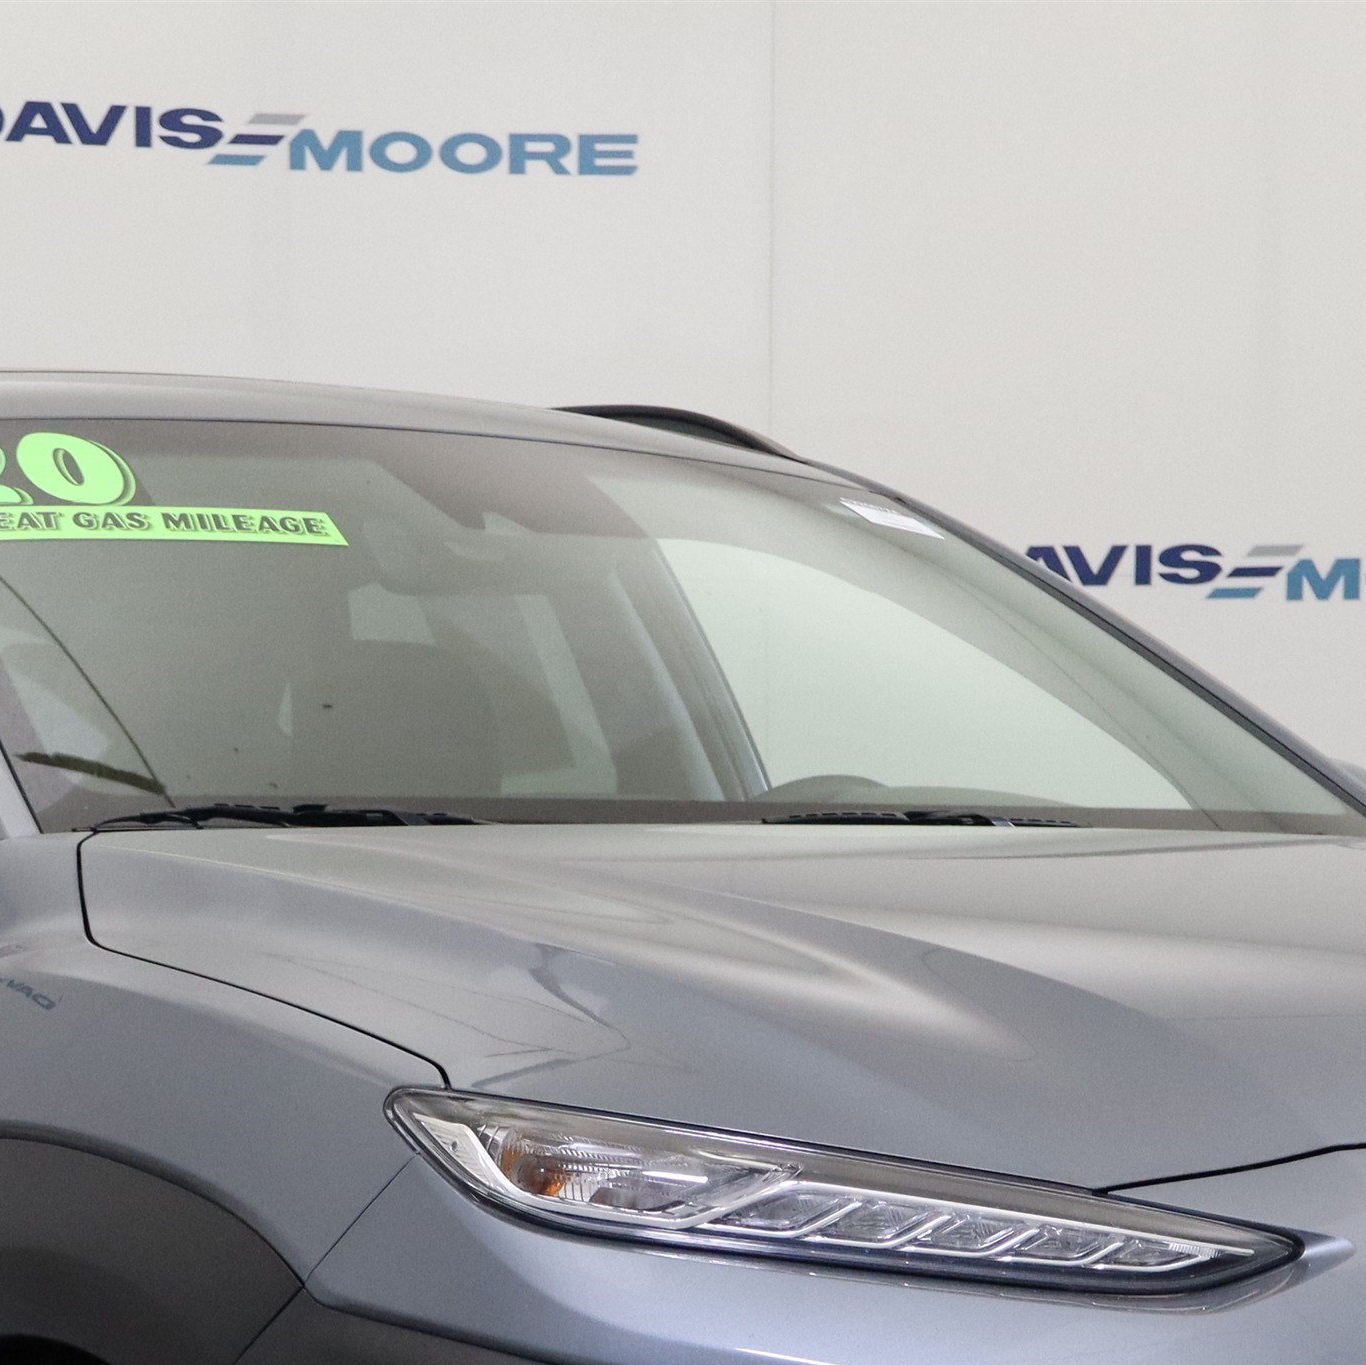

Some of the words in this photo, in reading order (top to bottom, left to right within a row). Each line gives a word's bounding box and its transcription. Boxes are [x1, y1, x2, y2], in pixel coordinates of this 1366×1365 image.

[288, 128, 639, 177] MOORE
[72, 511, 152, 531] GAS
[161, 512, 331, 537] MILEAGE
[1025, 544, 1221, 588] VIS
